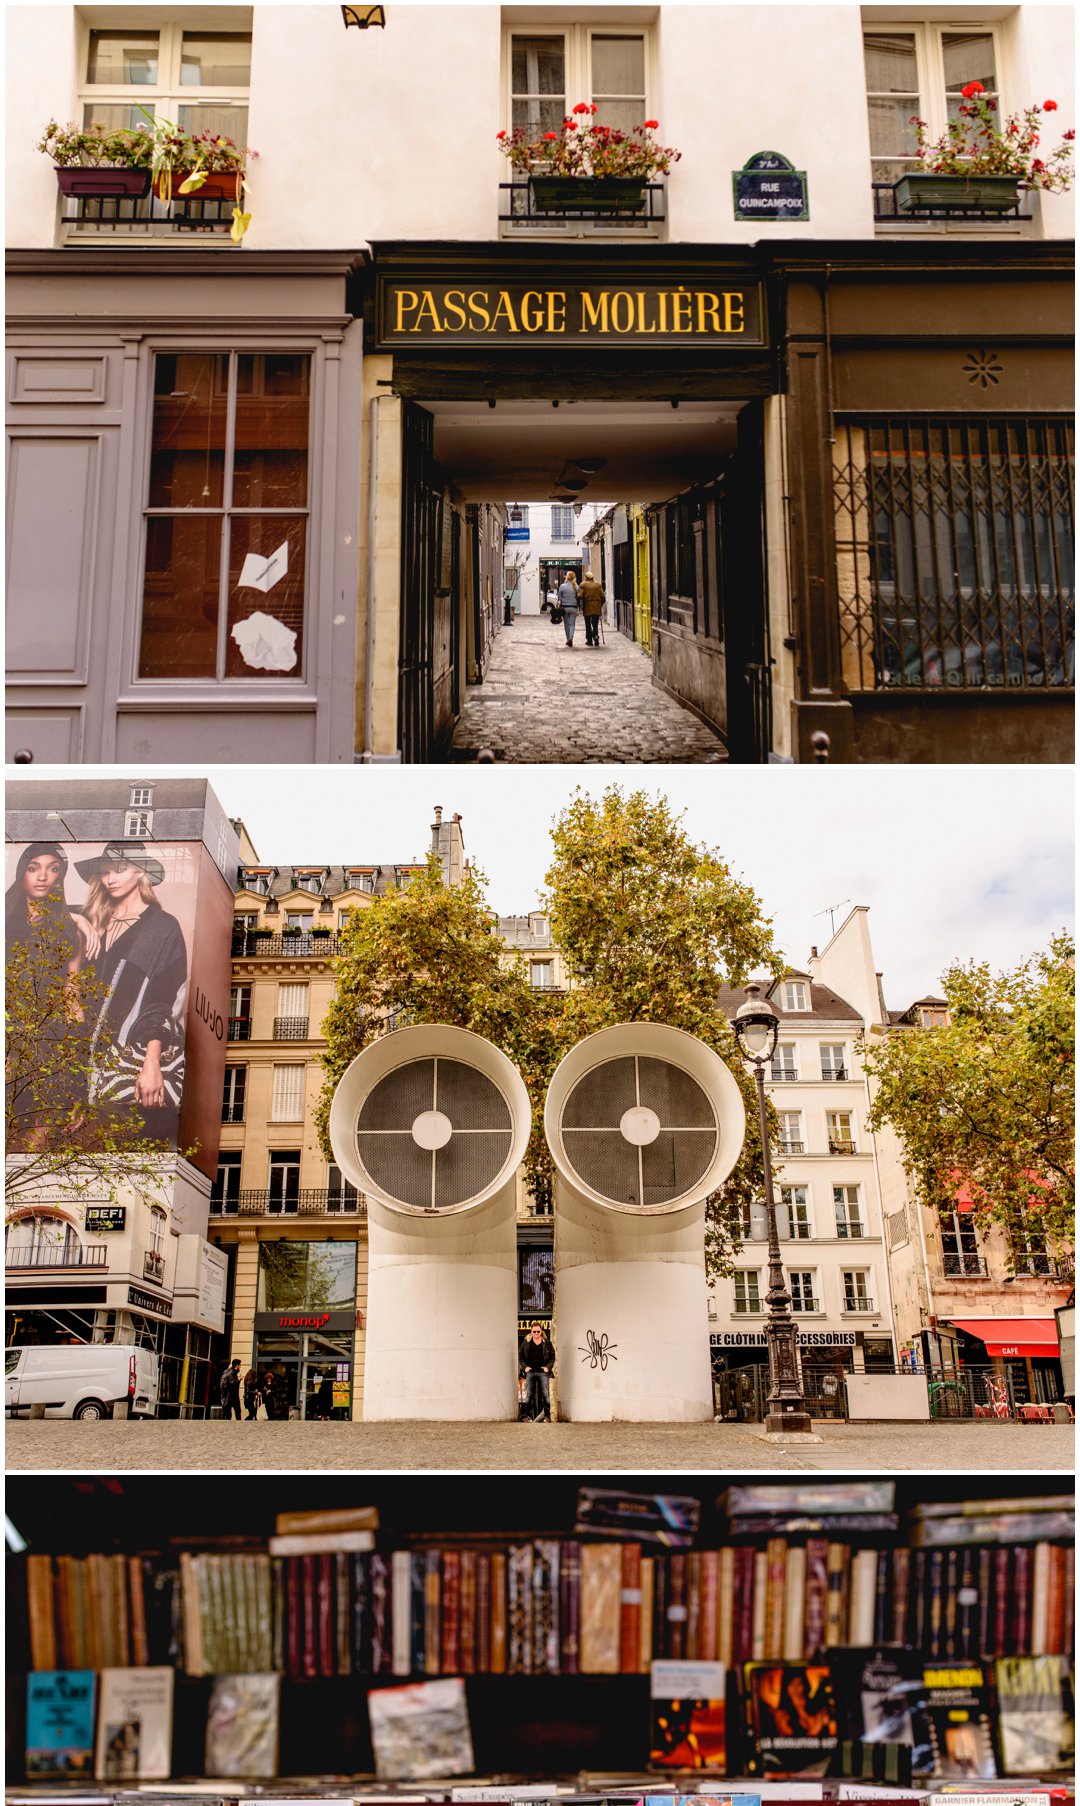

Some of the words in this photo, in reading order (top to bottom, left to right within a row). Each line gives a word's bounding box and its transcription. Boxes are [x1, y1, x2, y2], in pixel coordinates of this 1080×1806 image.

[760, 182, 780, 192] RUE
[739, 198, 803, 208] QUINCAMPOIX
[393, 290, 566, 333] PASSAGE
[579, 285, 745, 334] MOLIÈRE
[89, 1208, 123, 1219] DEFI
[724, 1333, 767, 1346] CLOTHIN
[795, 1333, 856, 1345] CCESSORIES
[1002, 1347, 1019, 1355] CAFÉ
[977, 1796, 1038, 1804] FLAMMARION
